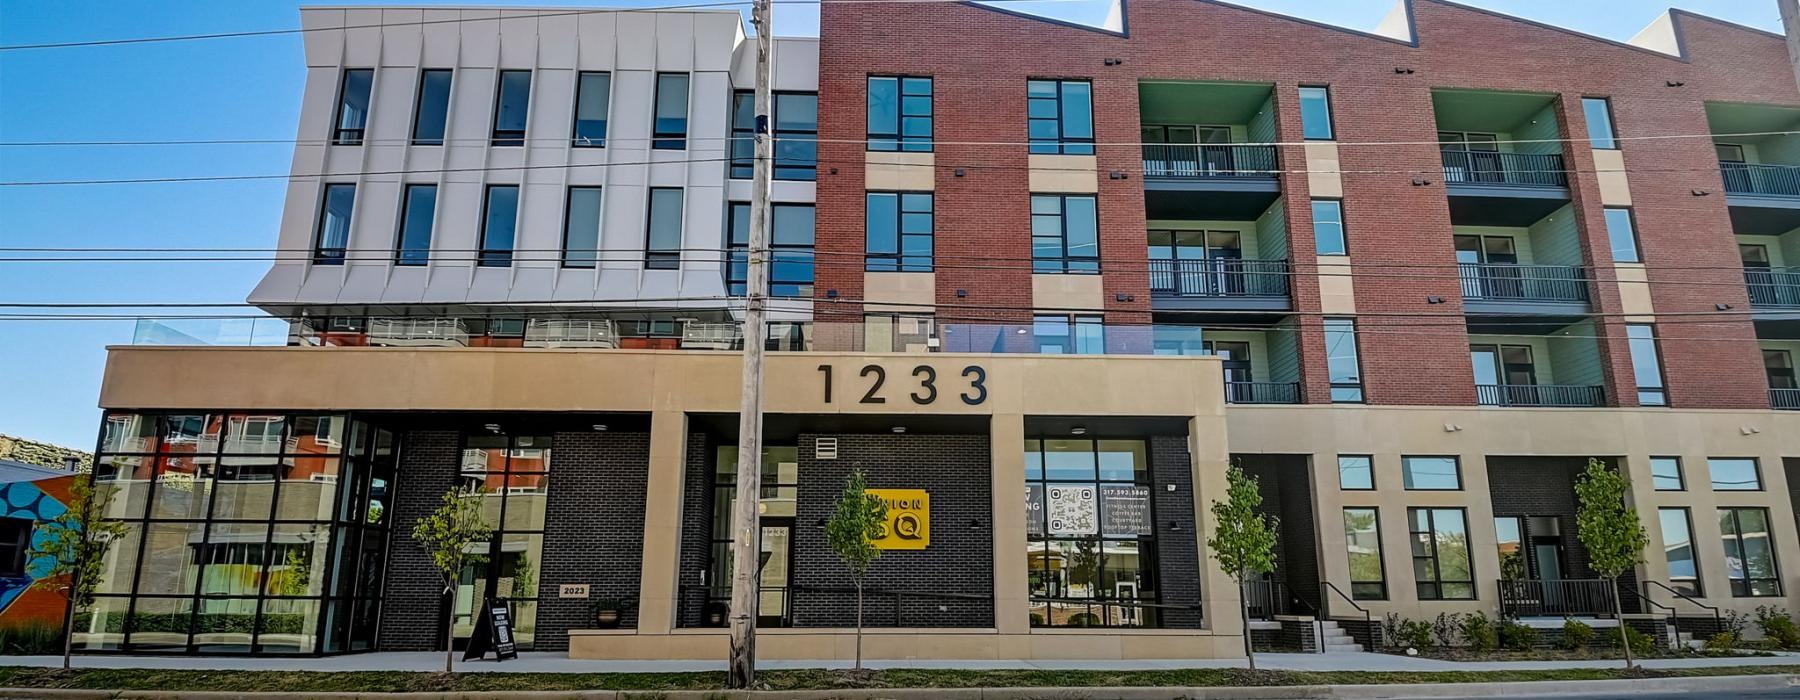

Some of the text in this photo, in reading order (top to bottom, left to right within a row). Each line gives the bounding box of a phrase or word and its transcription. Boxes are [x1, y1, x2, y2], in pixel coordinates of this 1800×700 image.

[817, 364, 988, 405] 1233
[879, 499, 922, 510] NION
[564, 587, 585, 595] 2023
